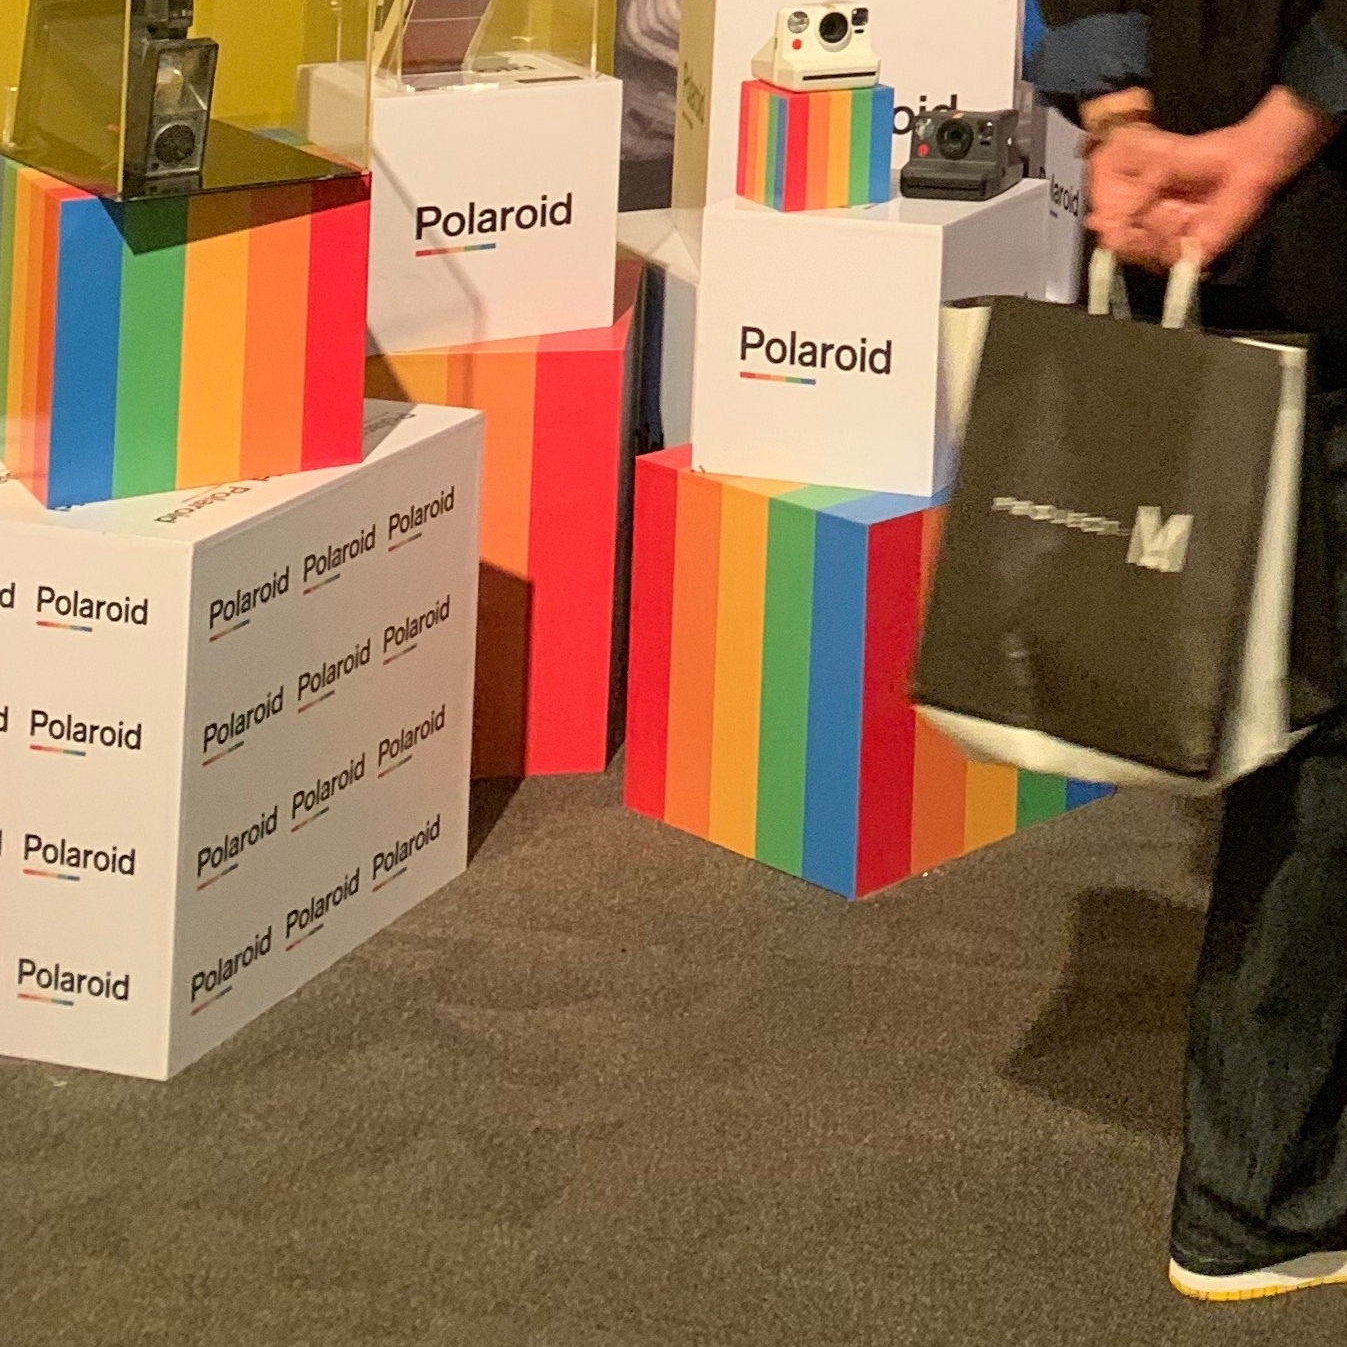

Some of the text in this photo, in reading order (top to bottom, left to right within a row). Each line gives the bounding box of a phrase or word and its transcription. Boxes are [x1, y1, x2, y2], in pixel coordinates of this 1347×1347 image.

[416, 192, 572, 240] Polaroid
[740, 326, 892, 375] Polaroid
[209, 486, 454, 629] Polaroid Polaroid Polaroid
[37, 586, 148, 626] Polaroid
[203, 594, 450, 752] Polaroid Polaroid Polaroid
[30, 710, 142, 750] Polaroid
[197, 704, 445, 877] Polaroid Polaroid Polaroid
[24, 833, 135, 875] Polaroid
[191, 814, 440, 1002] Polaroid Polaroid Polaroid
[18, 958, 129, 1000] Polaroid
